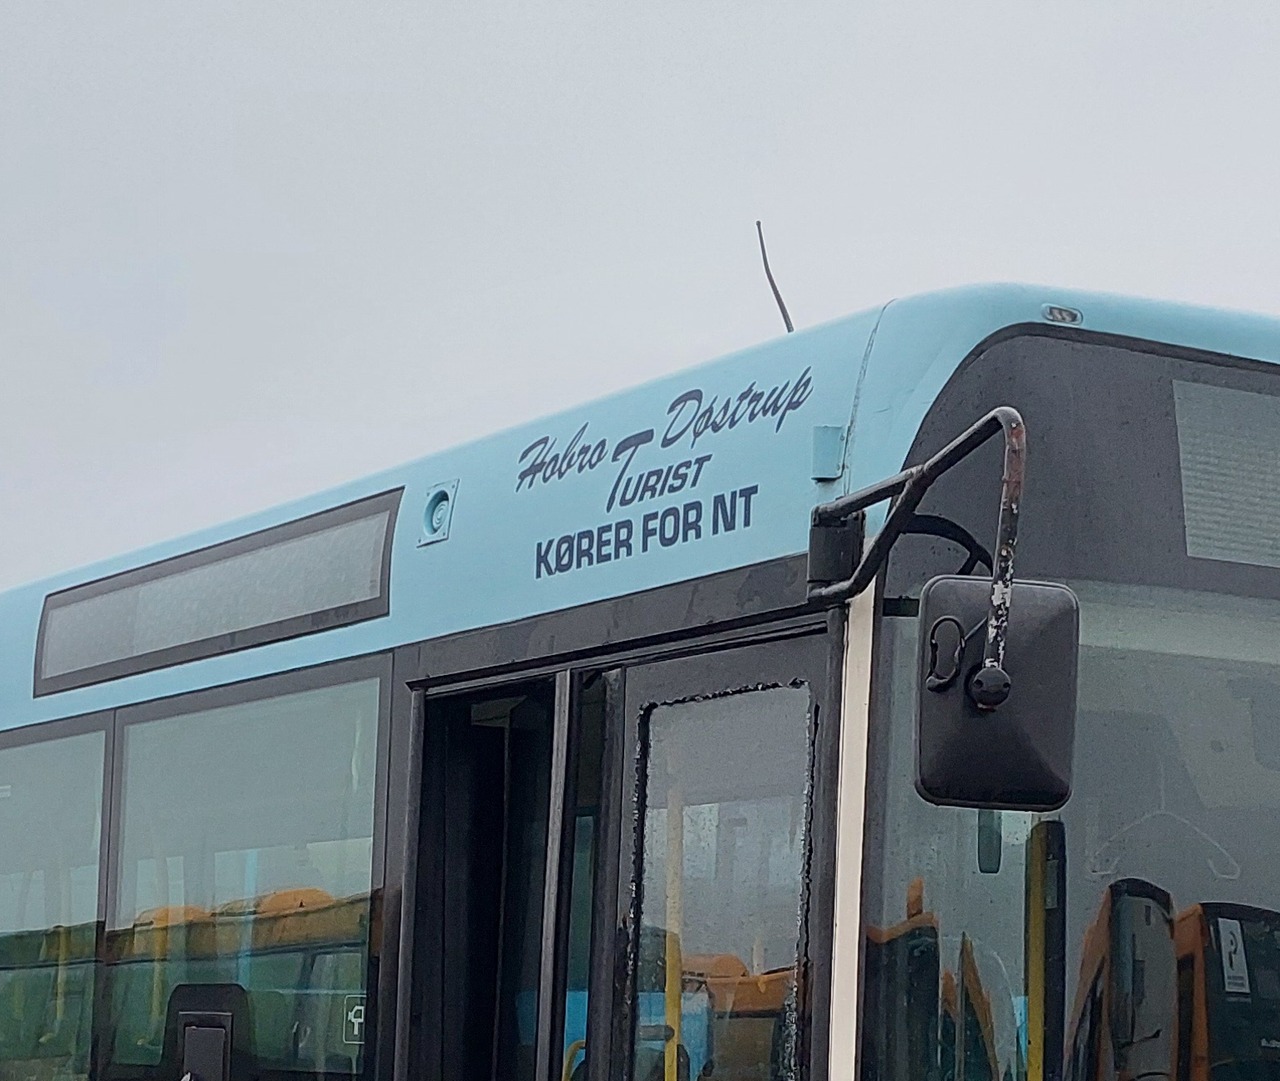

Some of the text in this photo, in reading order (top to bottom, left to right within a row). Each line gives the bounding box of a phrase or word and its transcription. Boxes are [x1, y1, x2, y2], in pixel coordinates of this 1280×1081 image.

[515, 365, 814, 493] Hobro Døstrup
[535, 484, 759, 579] KØRER FOR NT
